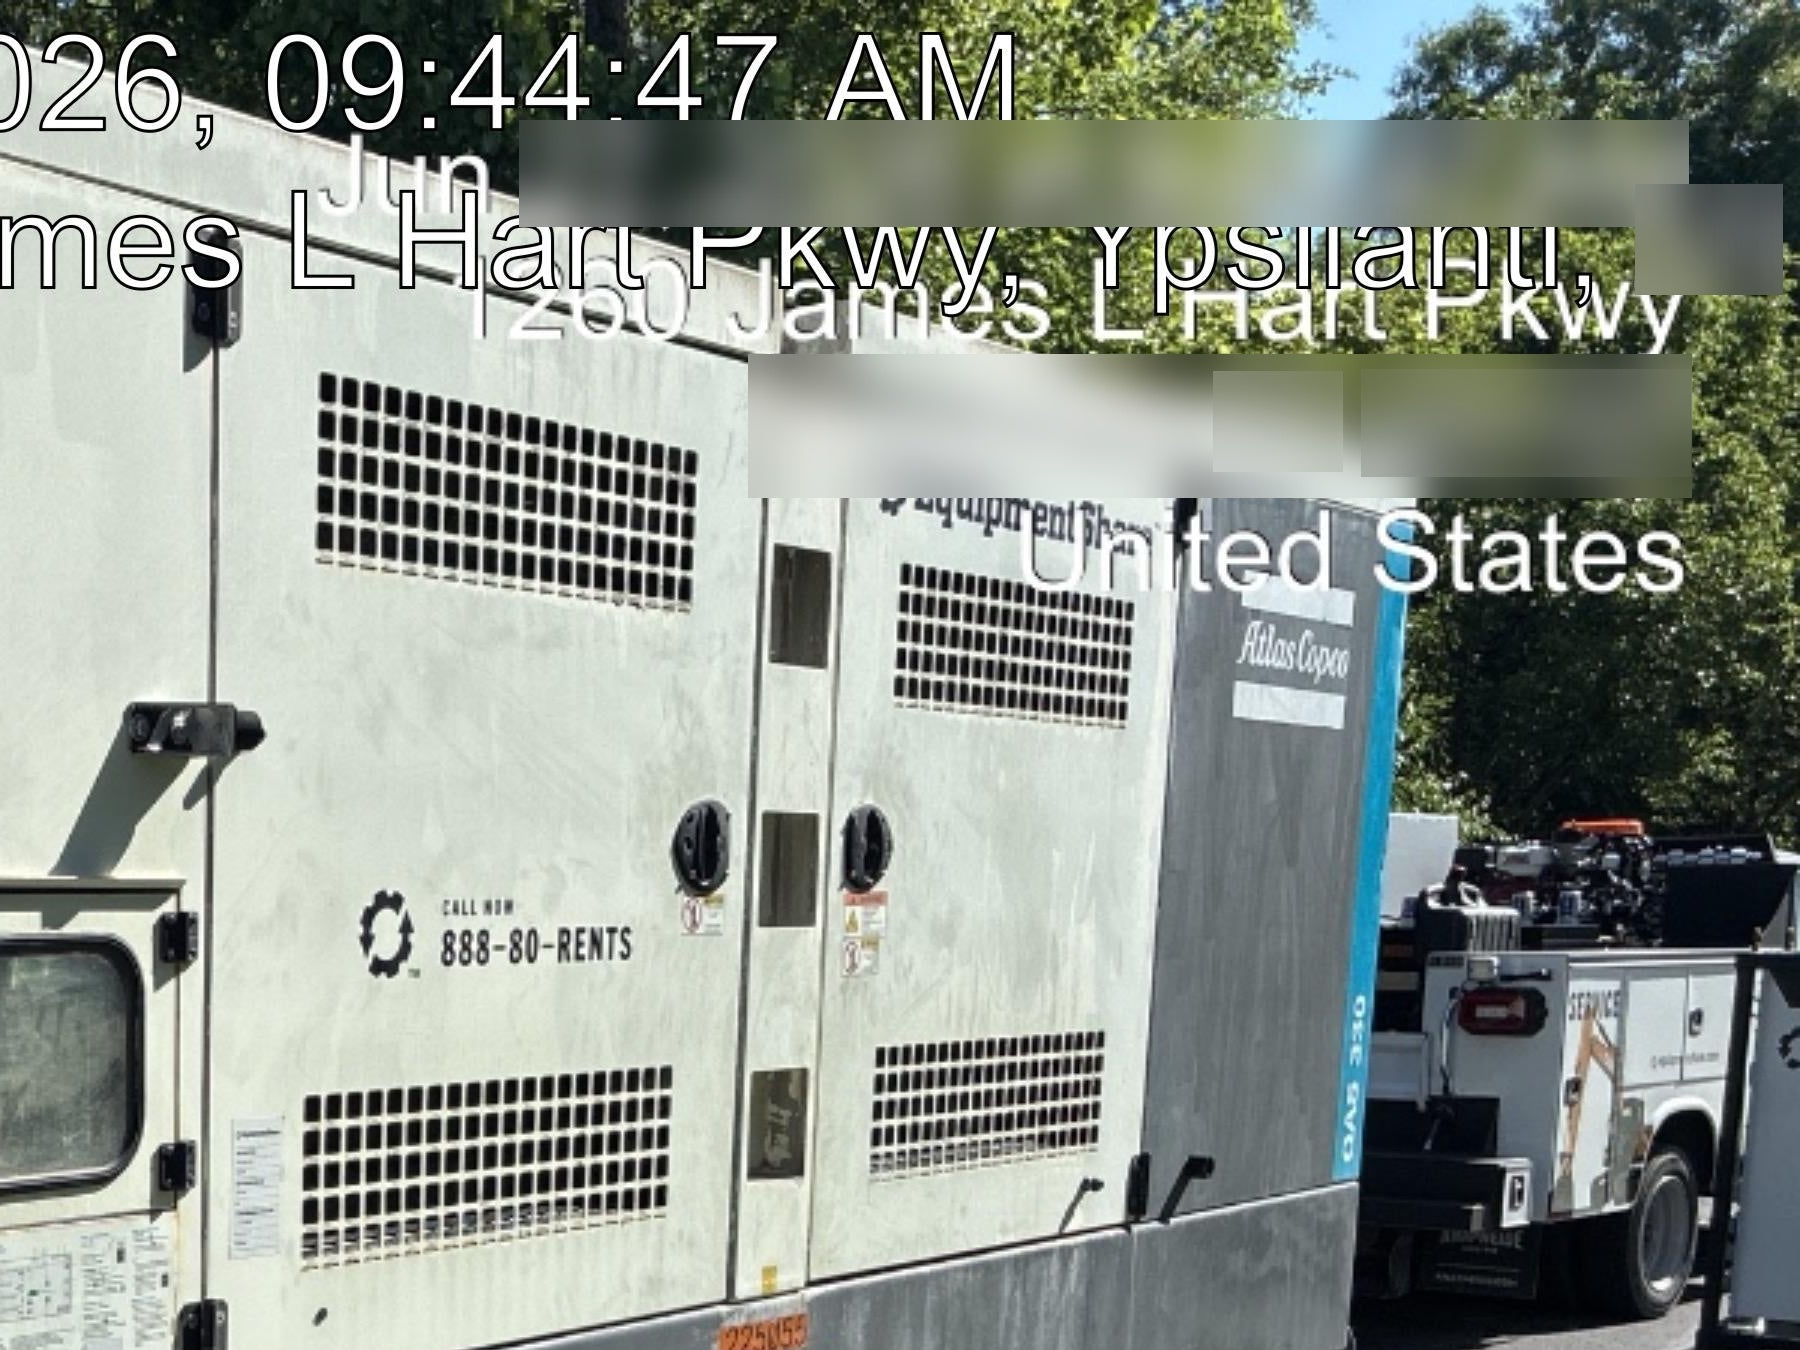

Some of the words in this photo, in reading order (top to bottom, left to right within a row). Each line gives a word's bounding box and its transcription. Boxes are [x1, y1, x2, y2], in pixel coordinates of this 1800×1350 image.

[1235, 620, 1296, 671] Atlas
[1297, 629, 1350, 685] Copco
[442, 898, 478, 917] CALL
[440, 926, 633, 967] 888-80-RENTS
